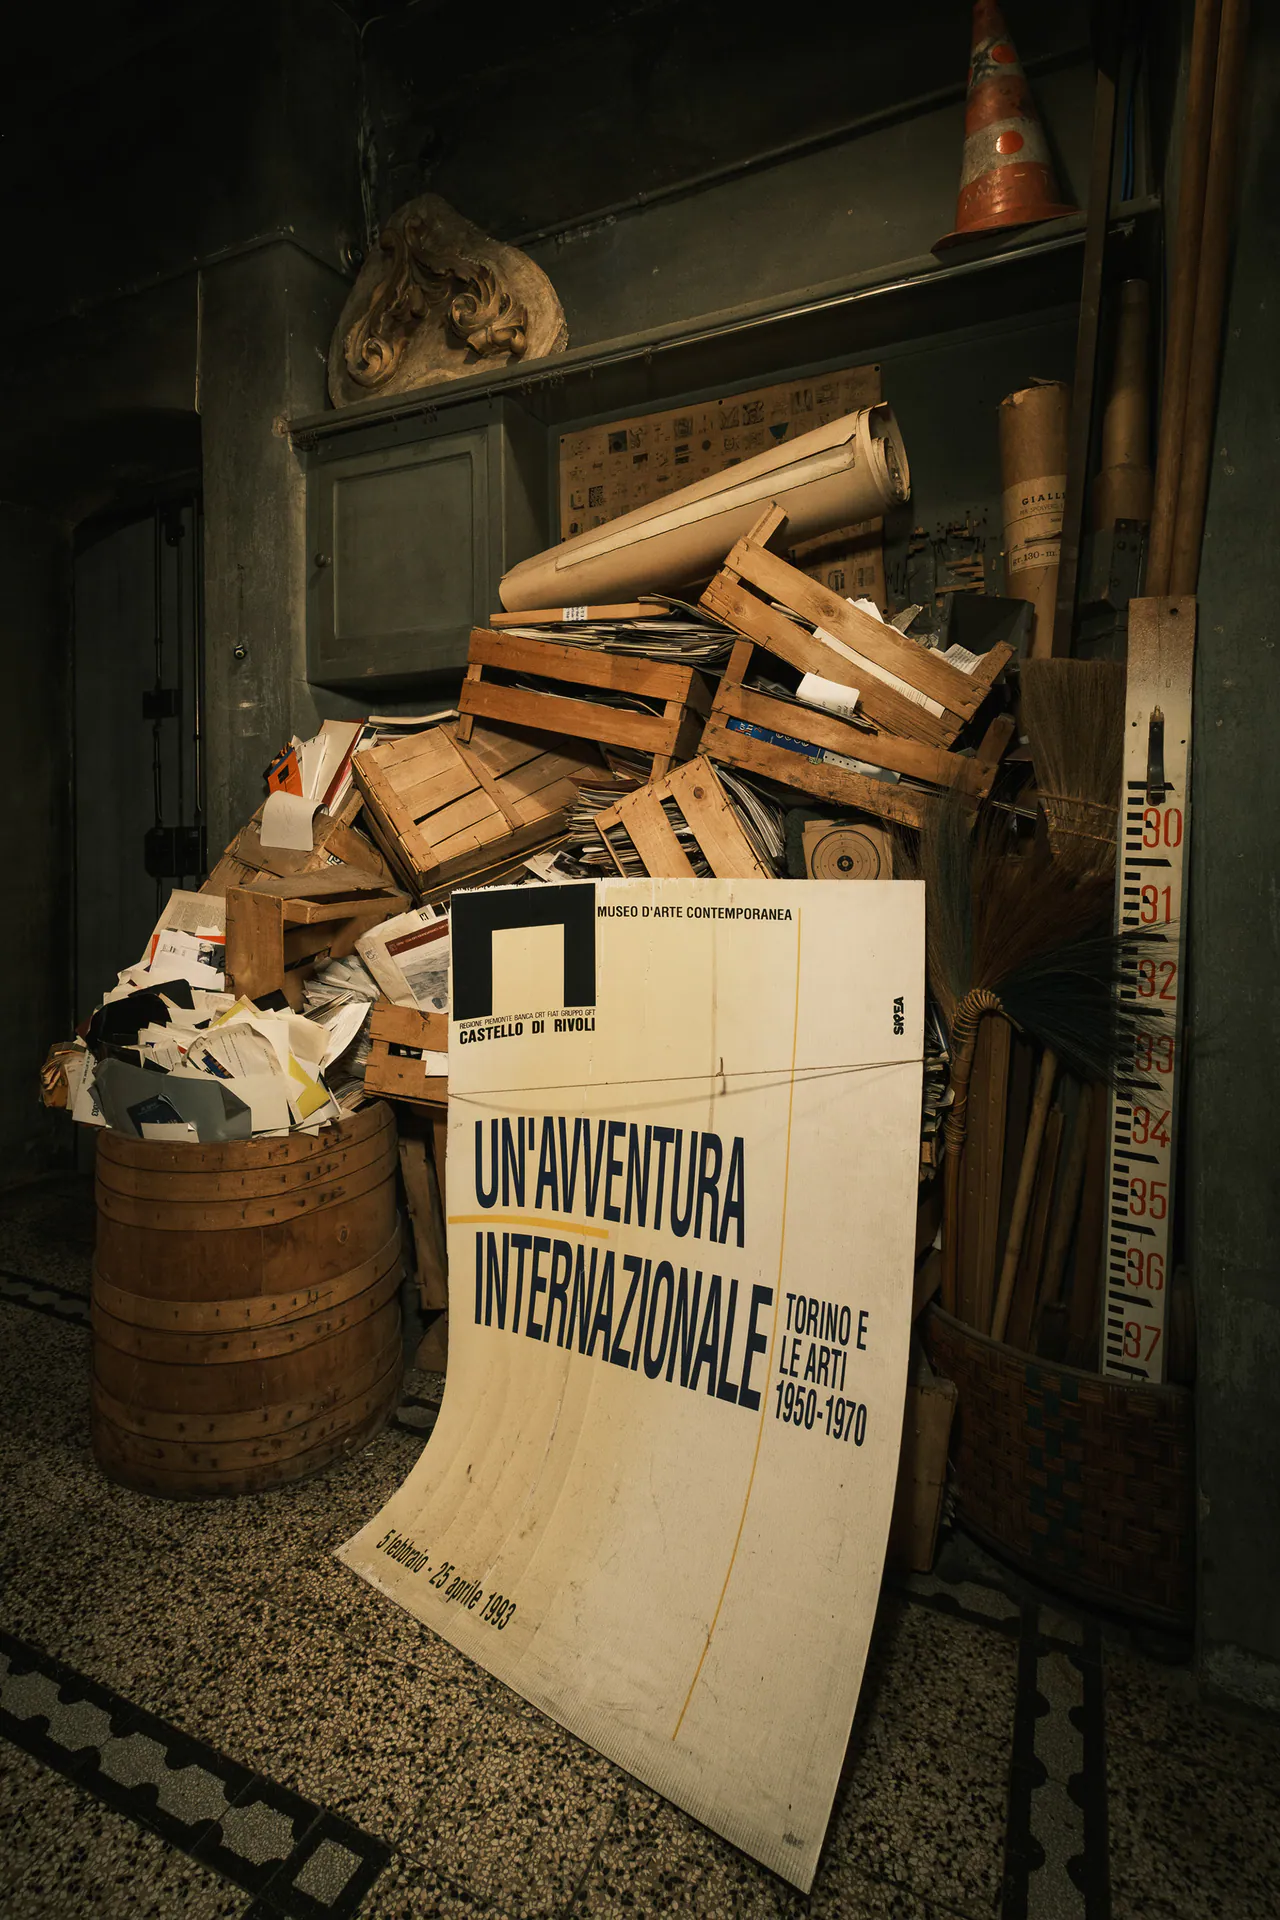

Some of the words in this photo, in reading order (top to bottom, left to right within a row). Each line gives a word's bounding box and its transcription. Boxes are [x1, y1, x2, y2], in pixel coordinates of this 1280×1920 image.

[1142, 806, 1184, 849] 30
[597, 905, 639, 918] MUSEO
[641, 906, 684, 919] D'ARTE
[686, 907, 793, 921] CONTEMPORANEA
[1140, 883, 1173, 925] 31
[1137, 958, 1178, 1001] 32
[459, 1020, 483, 1030] REGIONE
[484, 1015, 513, 1026] PIEMONTE
[514, 1012, 534, 1022] BANCA
[535, 1011, 546, 1019] CRT
[547, 1010, 559, 1018] FIAT
[560, 1009, 583, 1017] GRUPPO
[584, 1008, 596, 1016] GFT
[459, 1022, 524, 1045] CASTELLO
[531, 1019, 545, 1034] DI
[554, 1017, 596, 1033] RIVOLI
[1134, 1031, 1175, 1074] 33
[1131, 1105, 1172, 1149] 34
[474, 1115, 746, 1249] UN'AVVENTURA
[1128, 1177, 1168, 1220] 35
[1125, 1247, 1165, 1291] 36
[474, 1230, 774, 1412] INTERNAZIONALE
[786, 1292, 851, 1346] TORINO
[856, 1310, 869, 1351] E
[1123, 1321, 1162, 1362] 37
[779, 1335, 802, 1378] LE
[803, 1342, 848, 1392] ARTI
[775, 1379, 868, 1447] 1950-1970
[375, 1528, 397, 1549] 5
[383, 1533, 430, 1574] febbraio
[428, 1561, 456, 1589] 25
[444, 1576, 483, 1610] aprile
[479, 1591, 517, 1631] 1993
